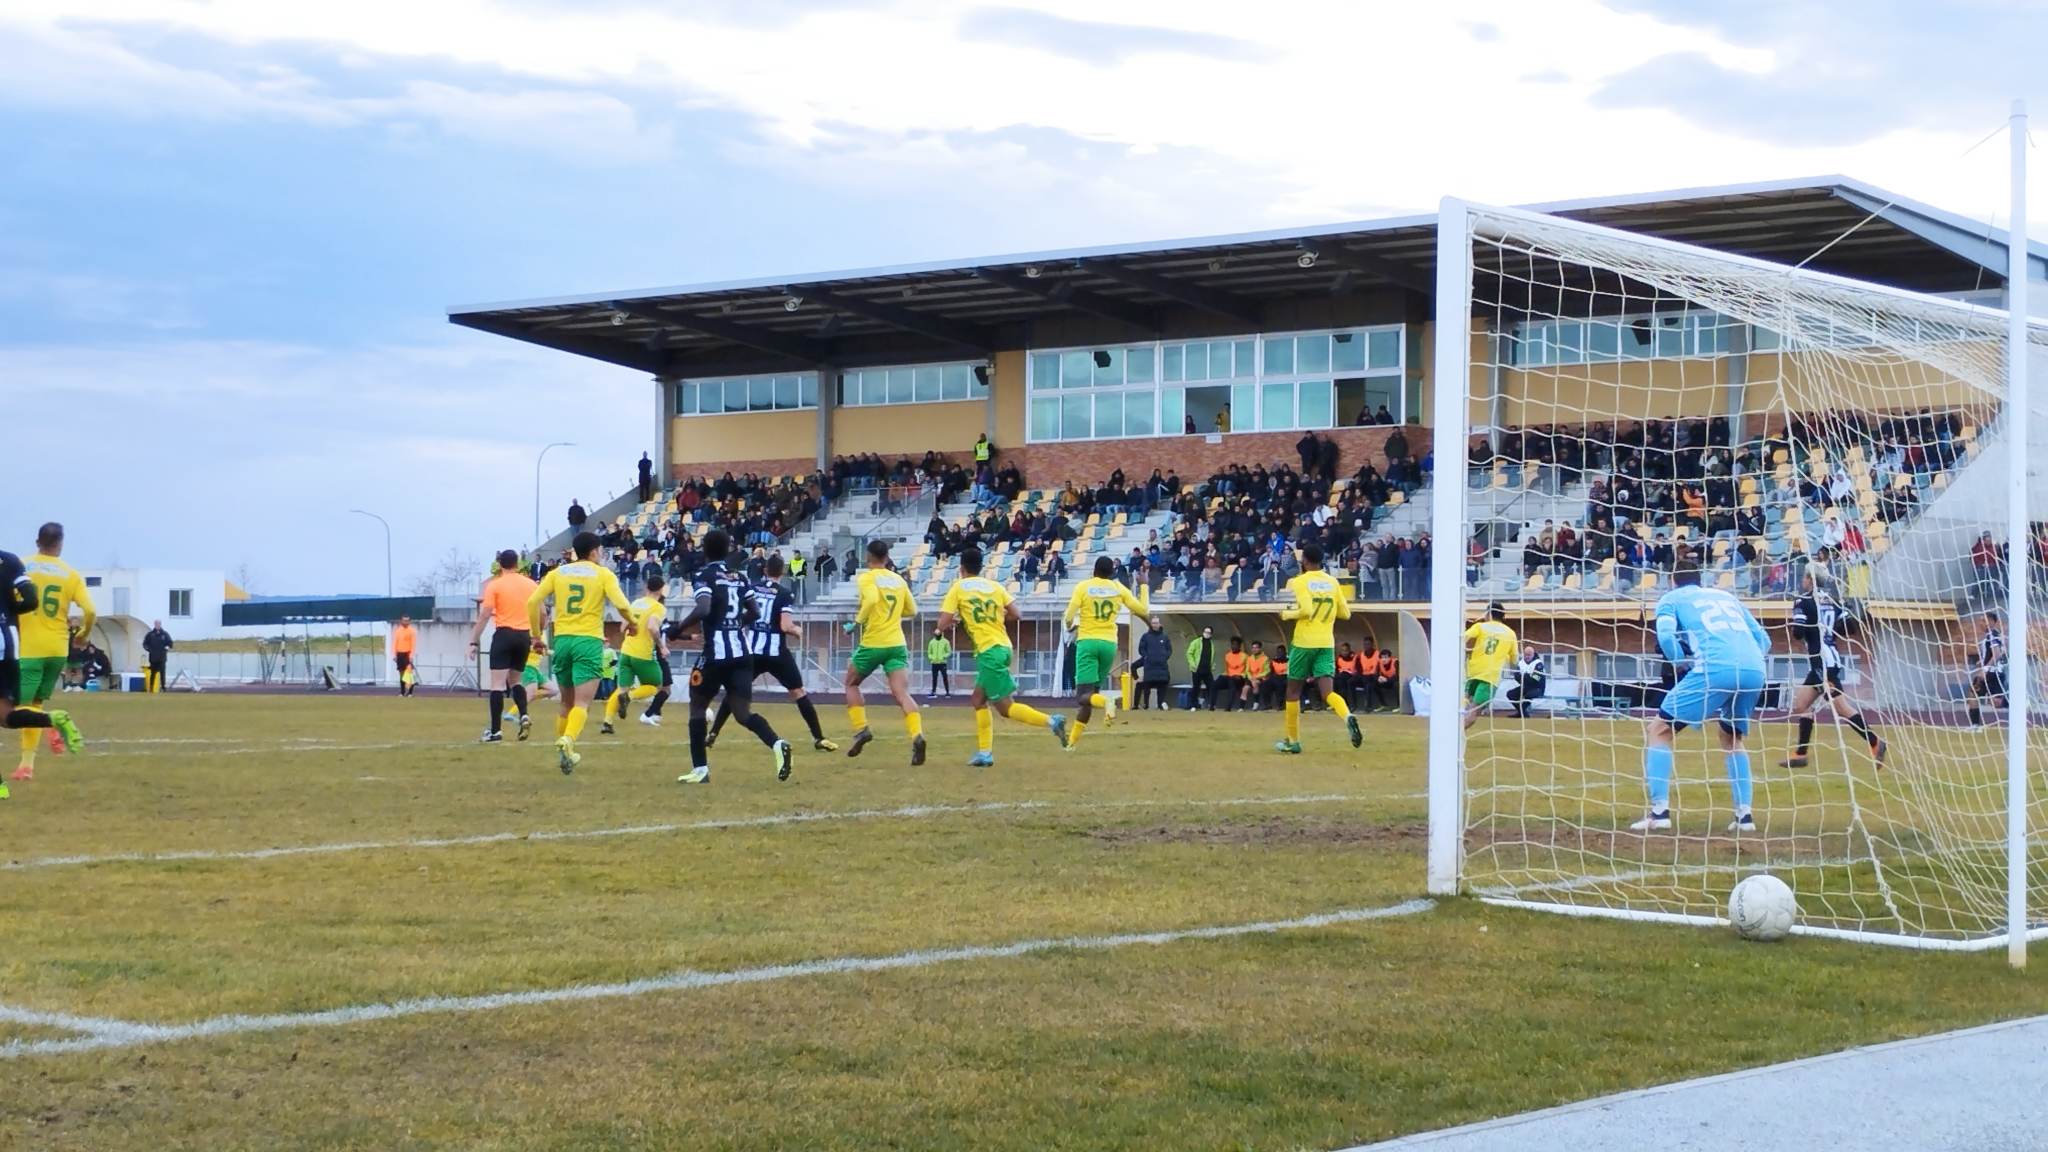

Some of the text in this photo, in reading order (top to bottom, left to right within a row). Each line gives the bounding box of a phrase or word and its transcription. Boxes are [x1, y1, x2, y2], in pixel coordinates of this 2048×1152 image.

[567, 584, 584, 614] 2
[886, 595, 897, 621] 7
[1093, 600, 1114, 620] 10
[1311, 597, 1334, 622] 77
[1692, 599, 1751, 633] 25
